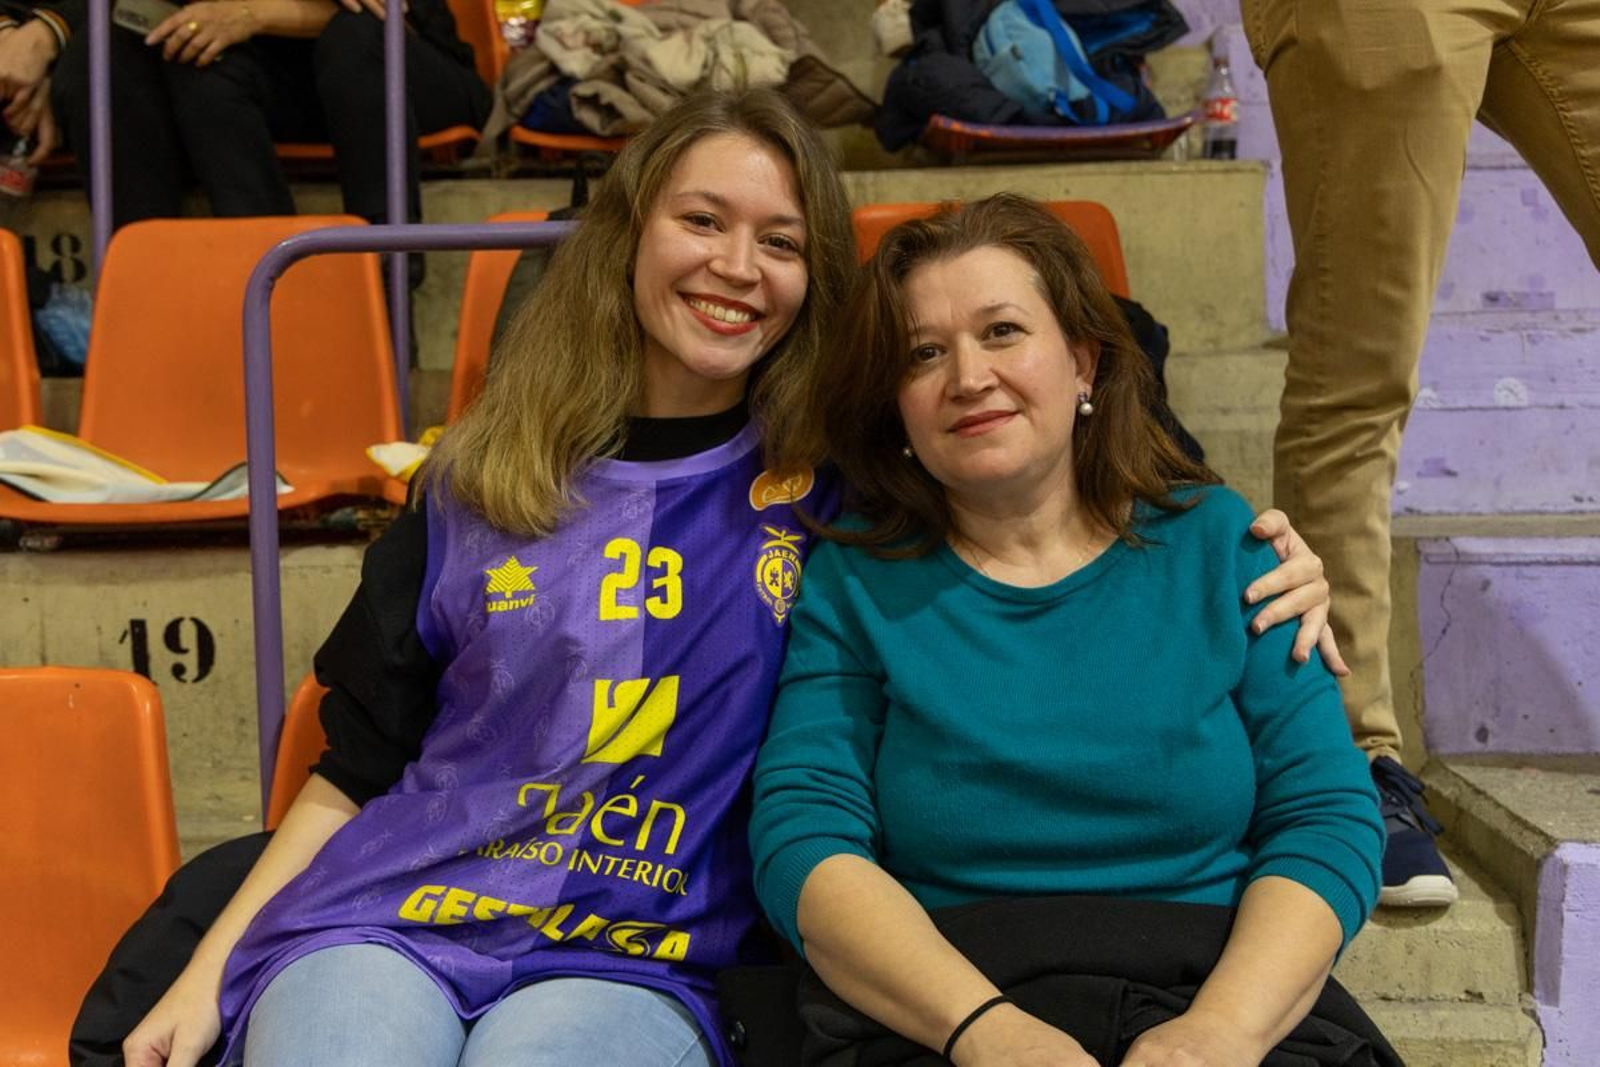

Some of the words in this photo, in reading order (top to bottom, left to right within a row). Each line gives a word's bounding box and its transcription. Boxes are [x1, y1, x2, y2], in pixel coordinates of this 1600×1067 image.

[599, 537, 683, 621] 23
[486, 594, 535, 613] uanvi
[118, 616, 216, 684] 19
[457, 837, 563, 866] RAÍSO
